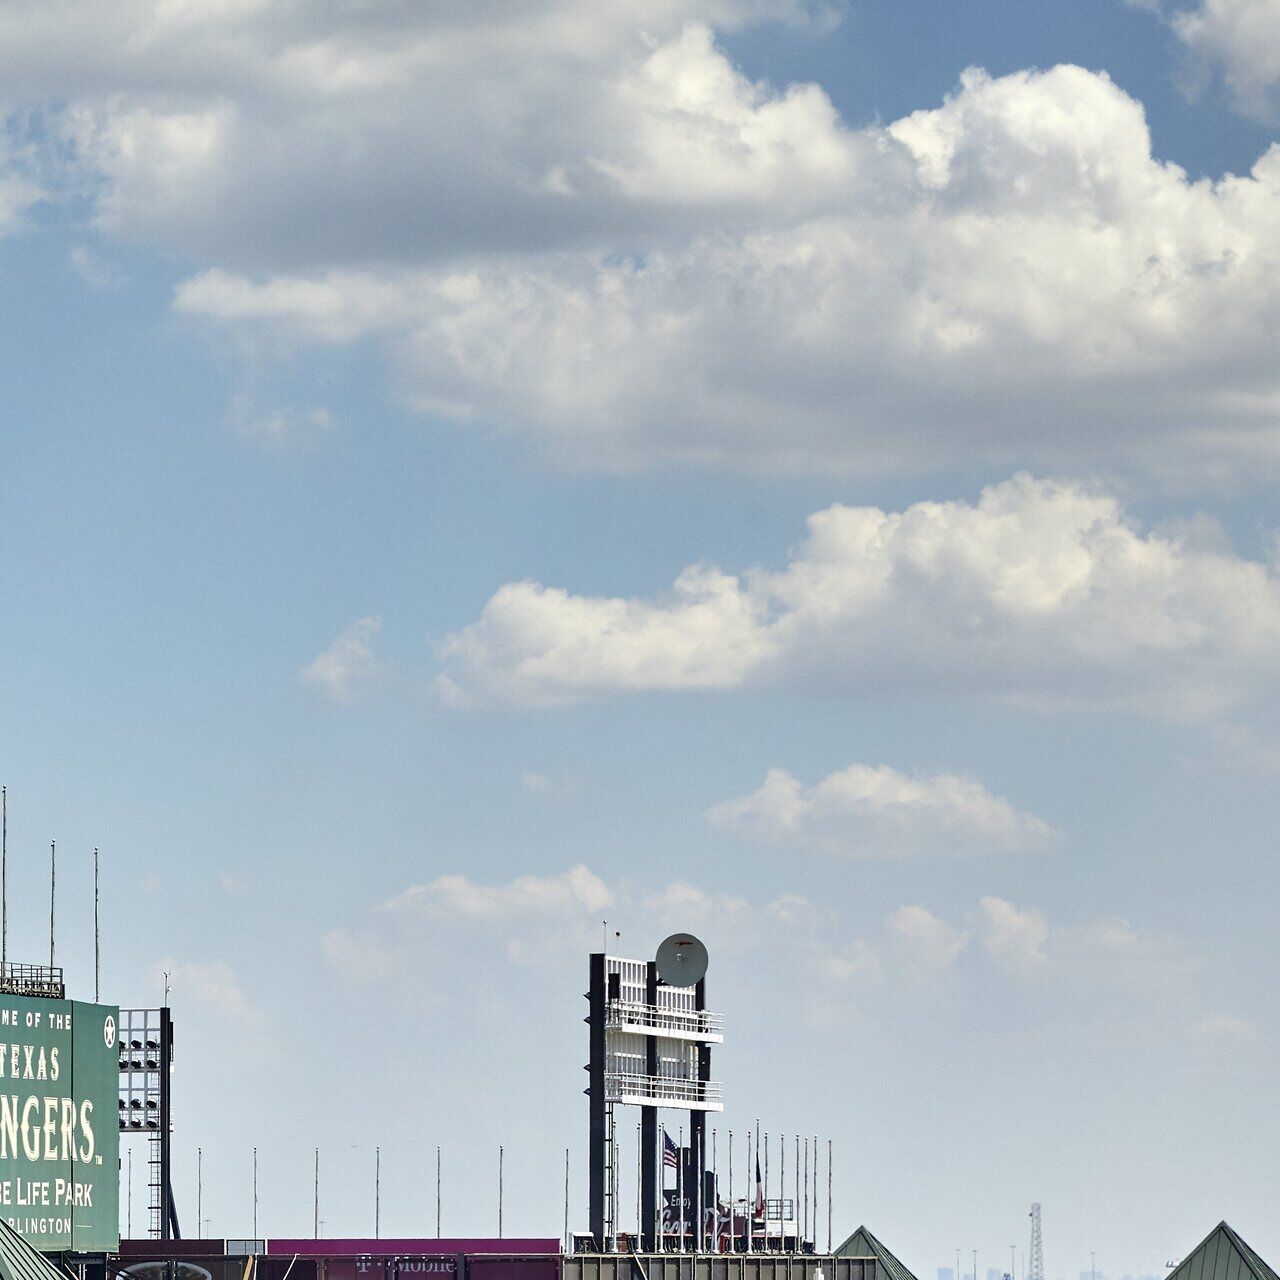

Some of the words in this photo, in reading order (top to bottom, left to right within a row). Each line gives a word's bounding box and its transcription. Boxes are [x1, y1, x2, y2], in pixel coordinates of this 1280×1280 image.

[26, 1012, 41, 1028] OF
[49, 1013, 71, 1030] THE
[16, 1177, 50, 1206] LIFE
[55, 1178, 93, 1208] PARK
[671, 1195, 691, 1209] Enoy
[8, 1217, 72, 1234] RLINGTON
